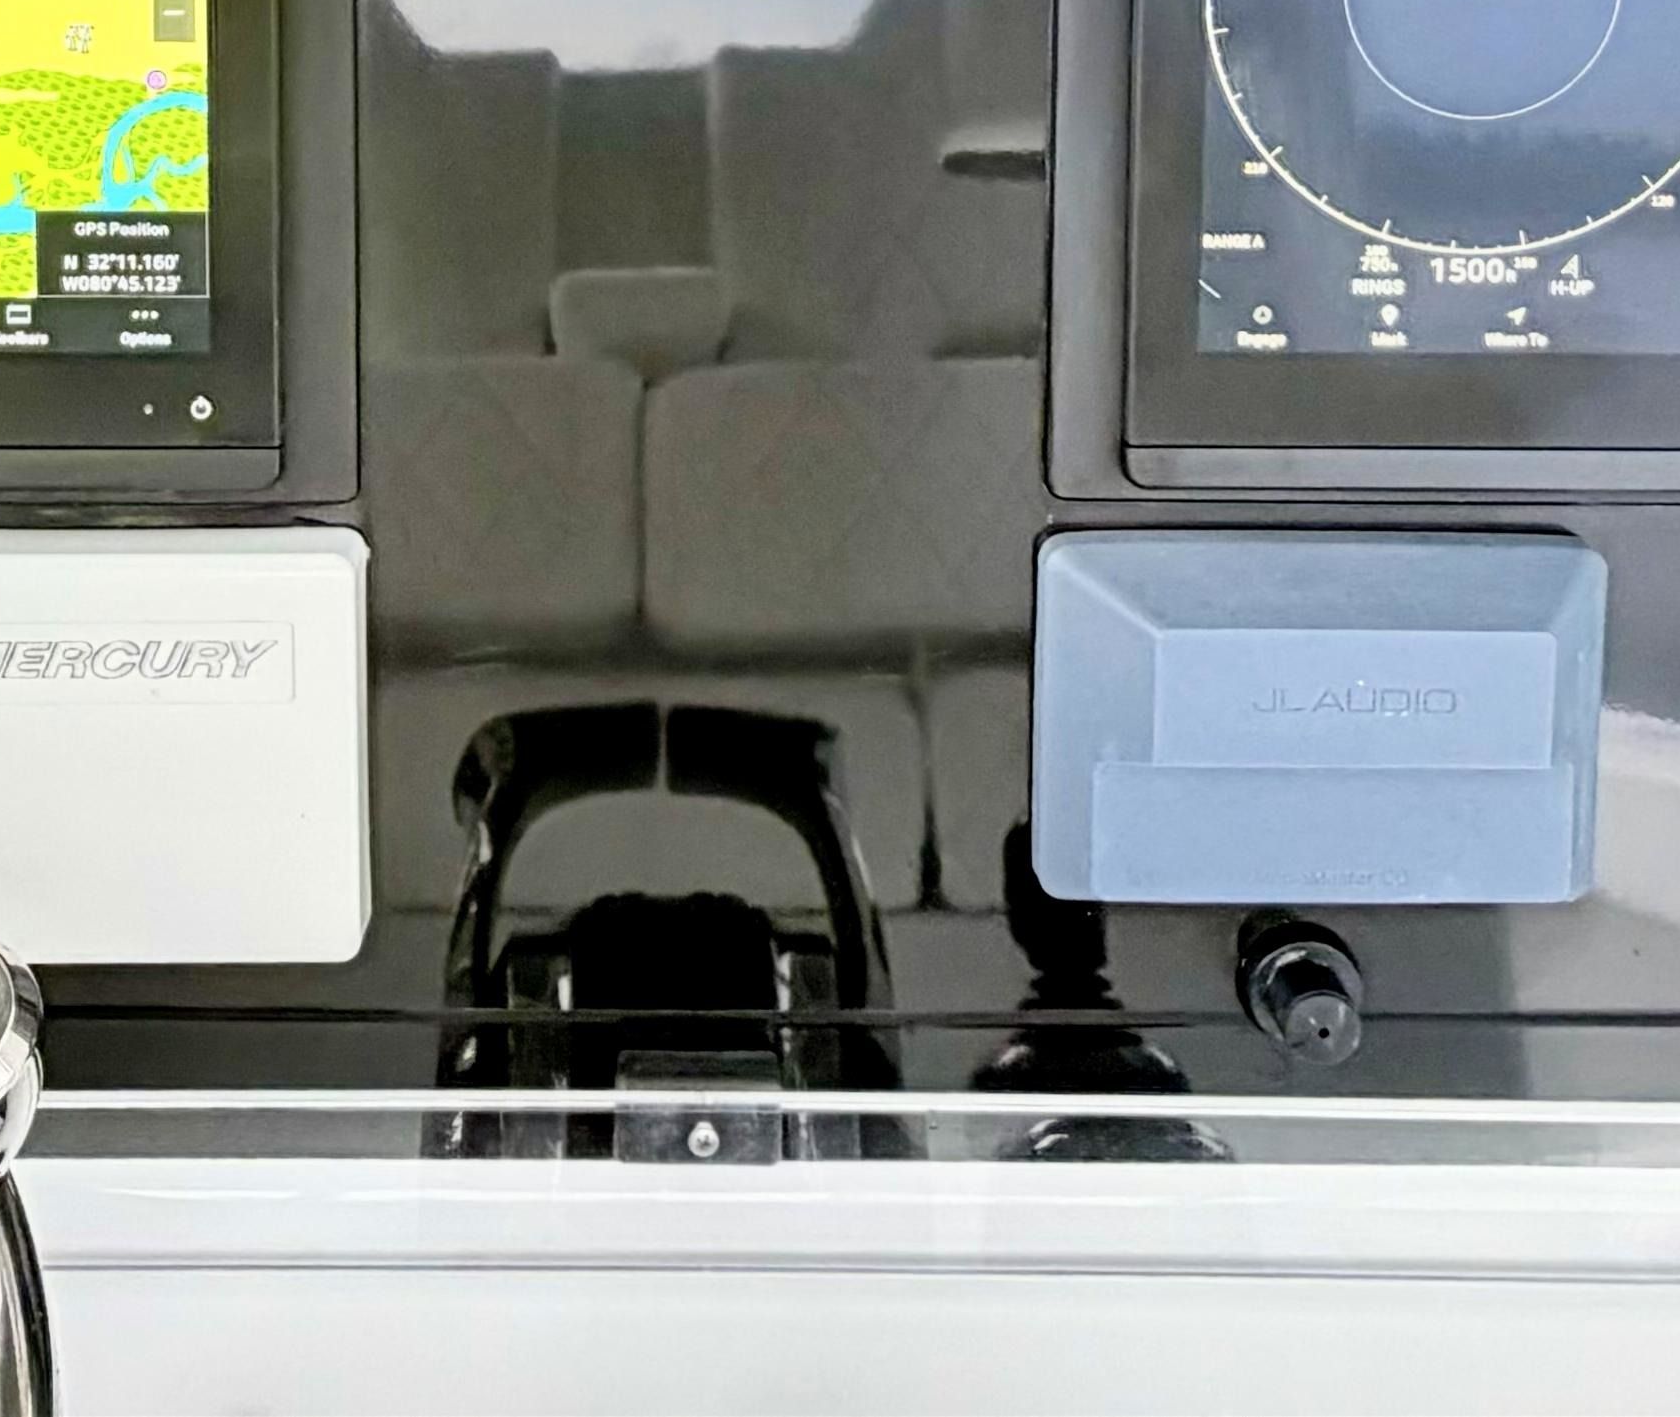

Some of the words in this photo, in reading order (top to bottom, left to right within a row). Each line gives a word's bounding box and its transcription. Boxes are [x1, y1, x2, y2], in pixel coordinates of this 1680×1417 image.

[74, 221, 107, 237] GPS
[108, 221, 170, 237] Position
[1201, 232, 1252, 249] RANGE
[1252, 232, 1266, 249] A
[63, 254, 79, 271] N
[1351, 278, 1407, 296] RINGS
[1549, 279, 1596, 297] H-UP
[119, 330, 173, 348] Options
[1251, 687, 1307, 713] JL
[1310, 687, 1457, 714] AUDIO
